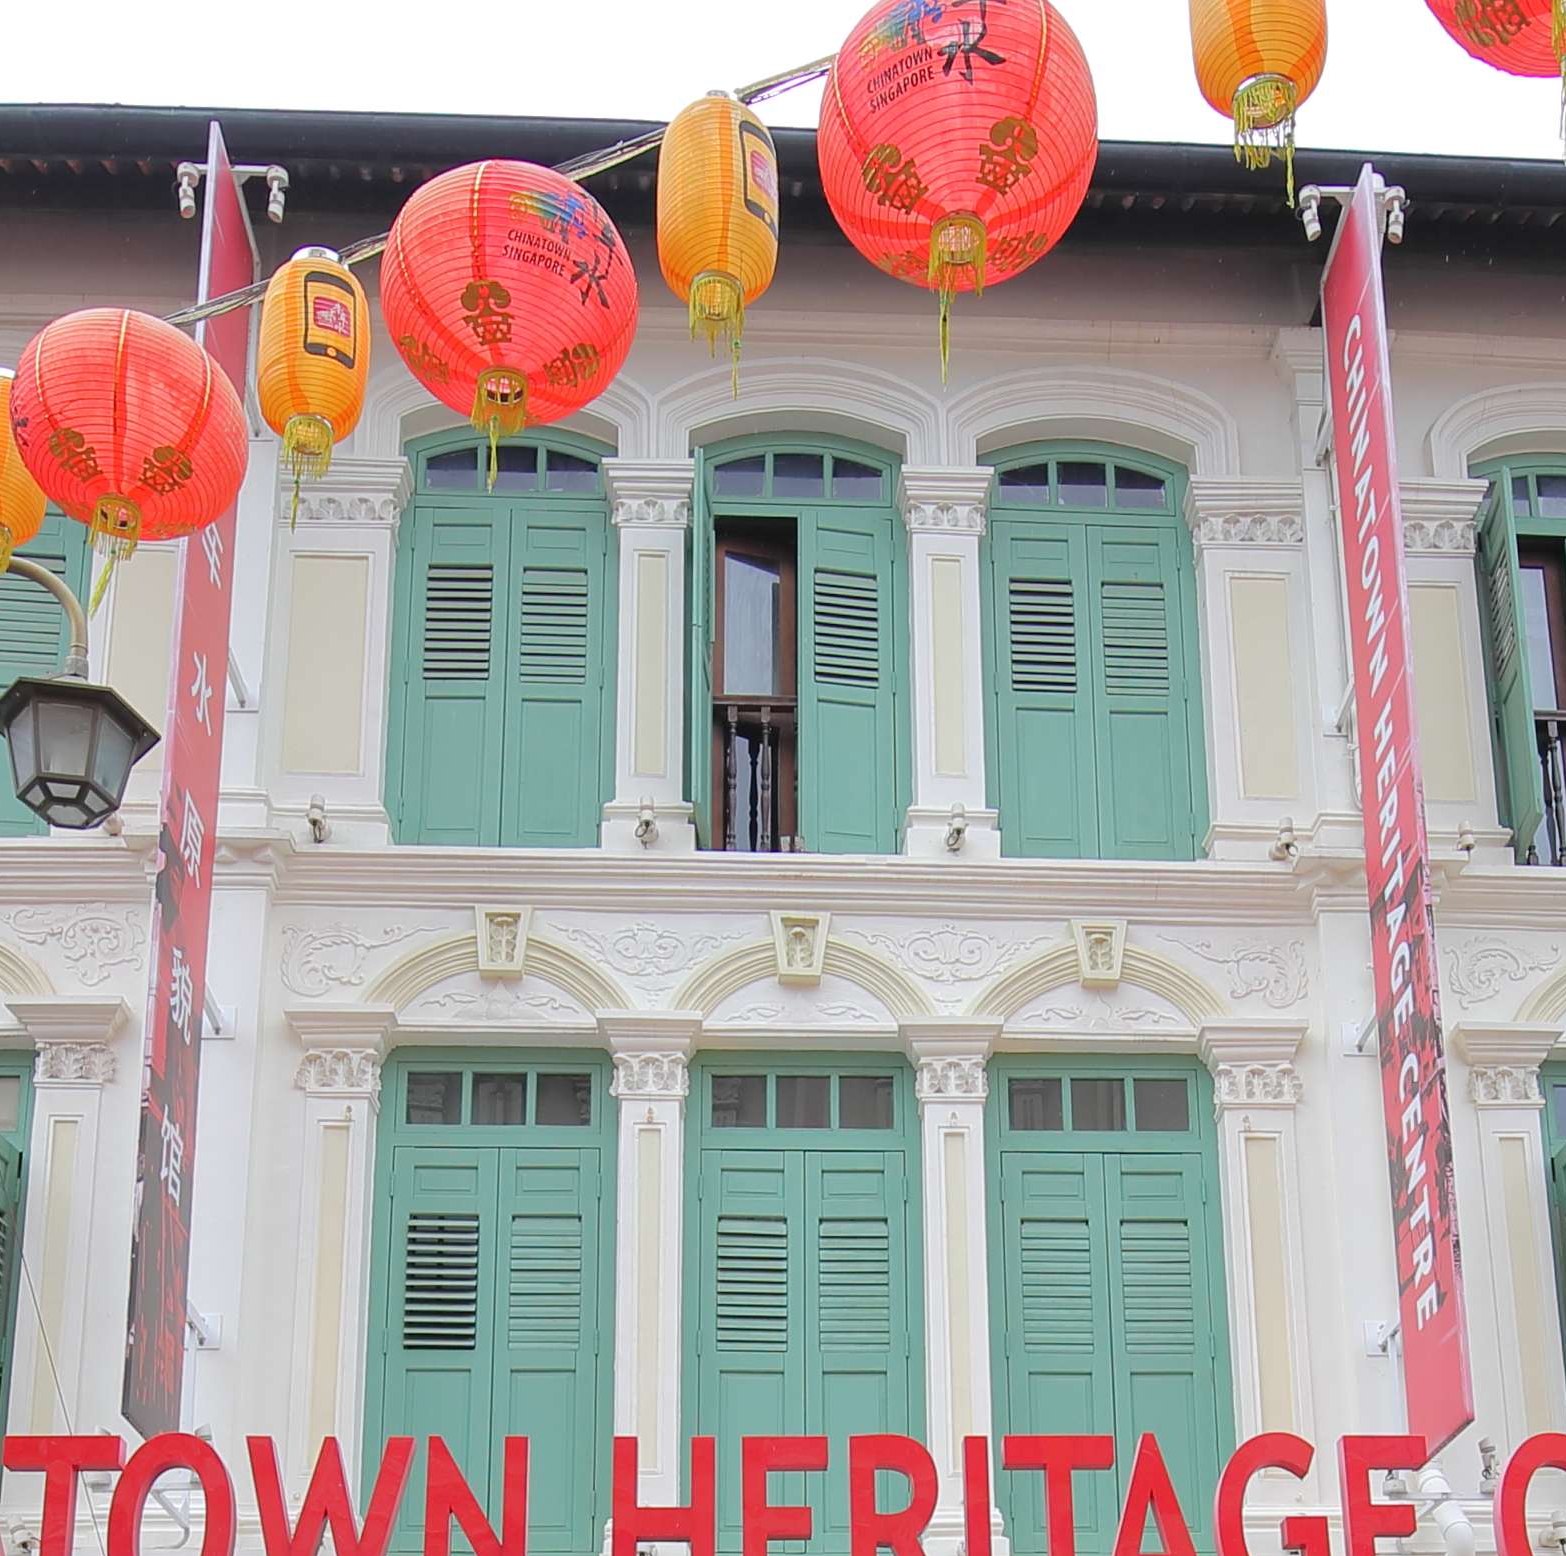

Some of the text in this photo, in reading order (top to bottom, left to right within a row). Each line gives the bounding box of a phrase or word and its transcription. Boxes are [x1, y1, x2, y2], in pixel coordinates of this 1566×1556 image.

[867, 47, 933, 94] CHINATOWN
[870, 65, 935, 113] SINGAPORE
[501, 244, 566, 279] SINGAPORE
[507, 228, 572, 262] CHINATOWN
[1342, 313, 1441, 1332] CHINATOWN HERITAGE CENTRE
[160, 522, 224, 1207] 车水原貌馆
